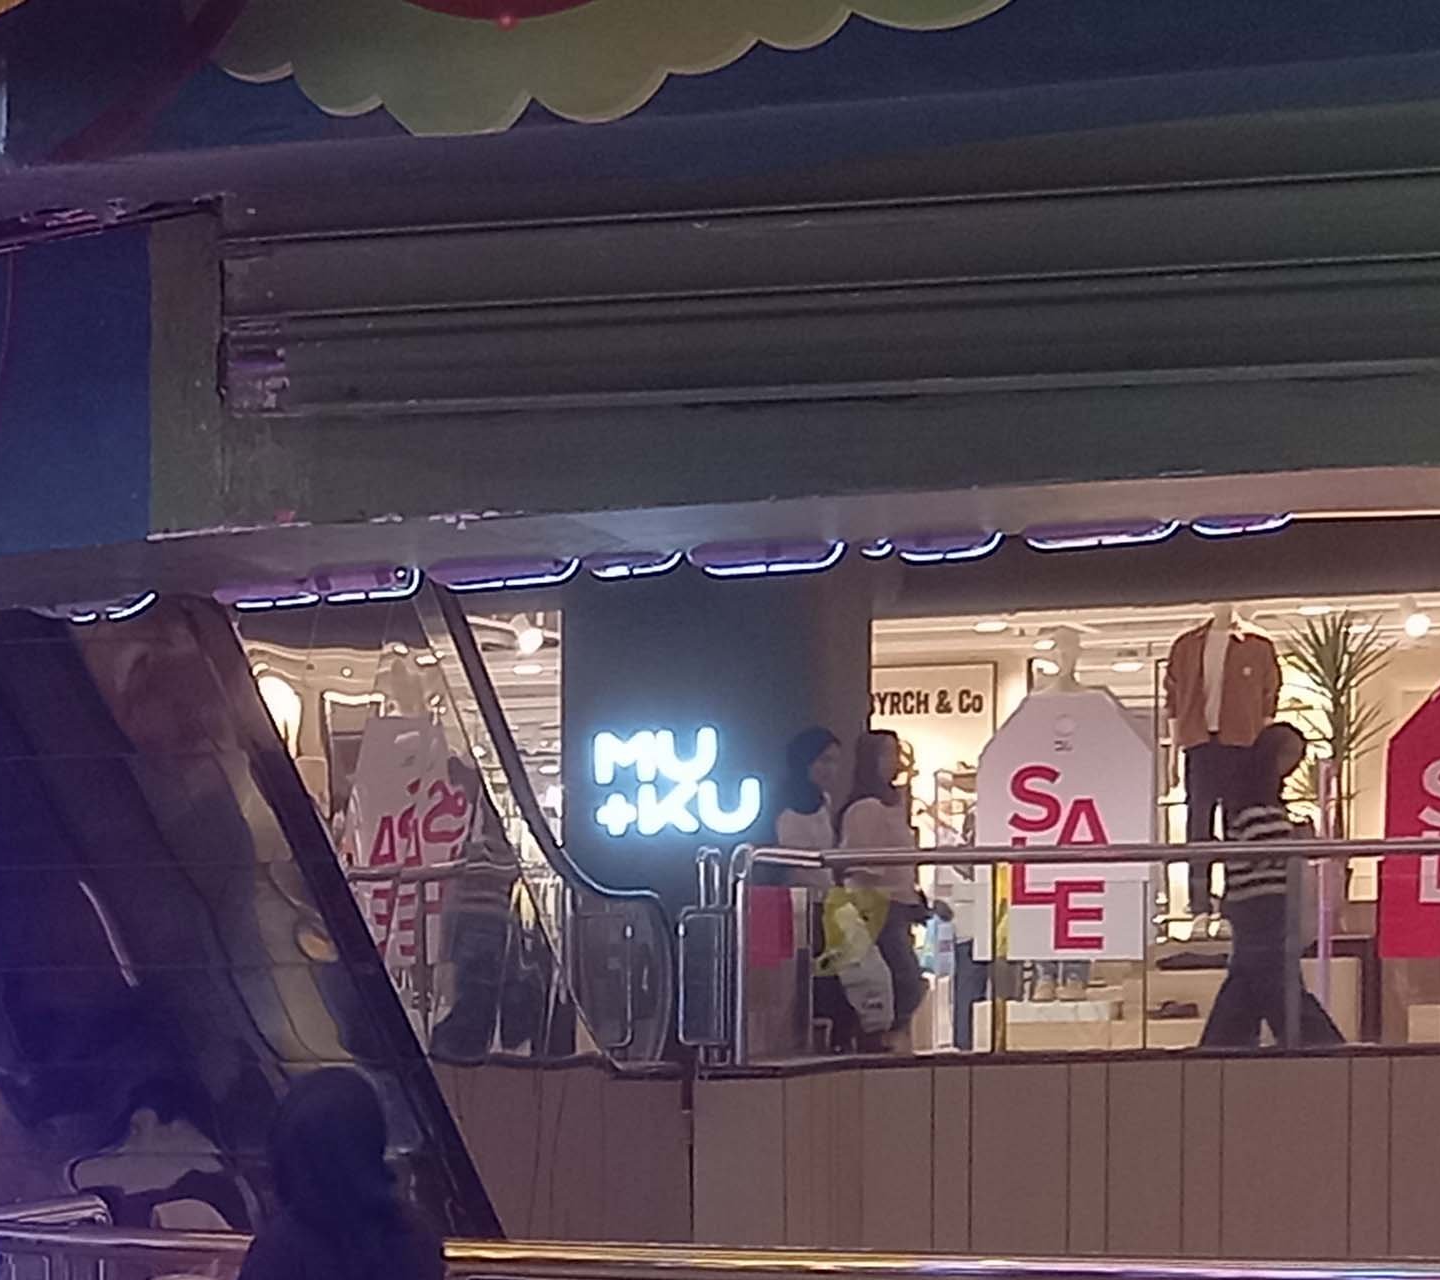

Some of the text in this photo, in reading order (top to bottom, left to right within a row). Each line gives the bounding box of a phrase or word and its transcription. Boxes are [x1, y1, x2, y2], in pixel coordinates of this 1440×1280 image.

[871, 690, 929, 716] YRCH
[935, 689, 953, 714] &
[594, 725, 718, 785] MU
